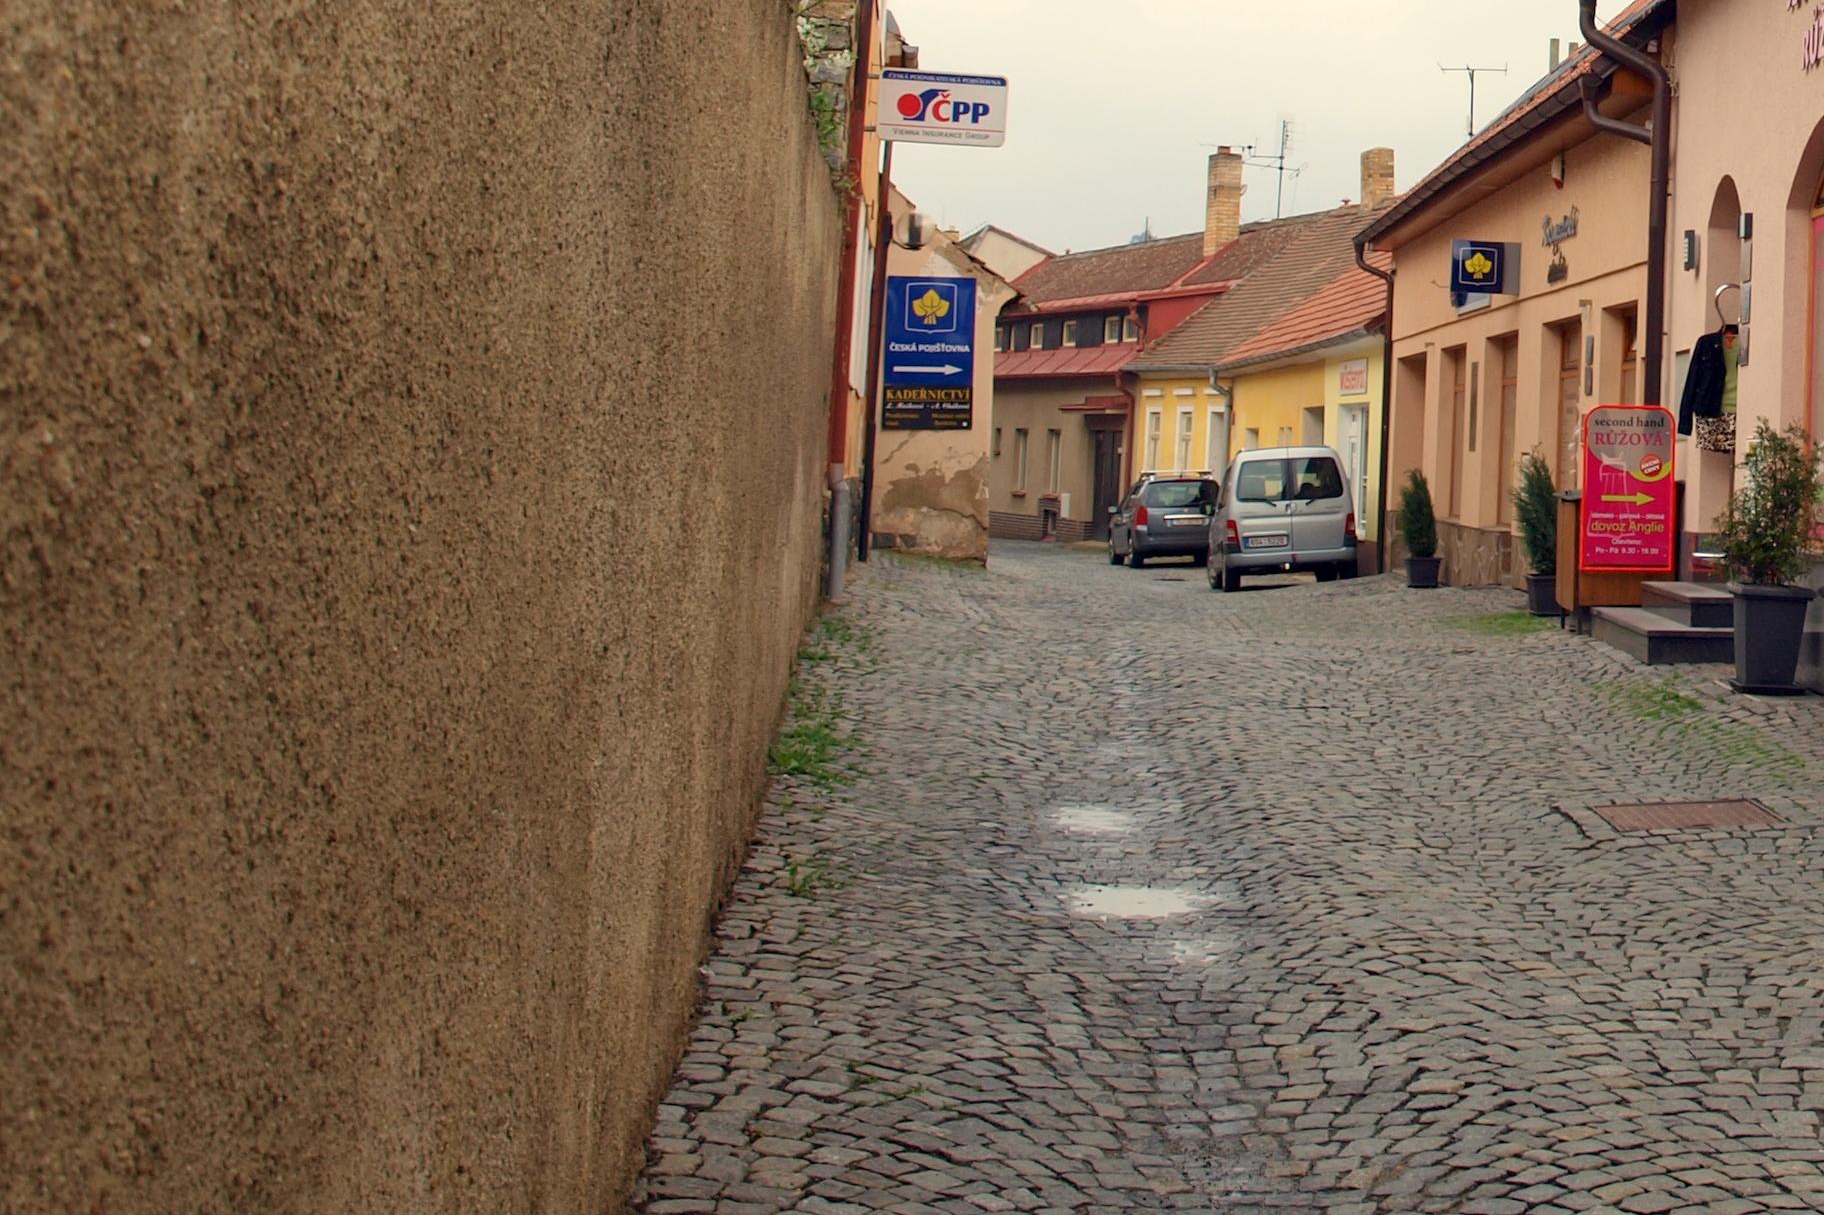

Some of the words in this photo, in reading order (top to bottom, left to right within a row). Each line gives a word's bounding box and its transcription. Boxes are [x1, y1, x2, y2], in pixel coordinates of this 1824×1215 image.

[932, 92, 990, 124] ČPP
[889, 341, 917, 352] ČESKÁ
[886, 388, 970, 400] KADEŘNICTVÍ
[1594, 417, 1634, 427] second
[1637, 417, 1664, 428] hand
[1595, 430, 1664, 445] RŮŽOVÁ
[1591, 521, 1626, 532] dovoz
[1628, 521, 1664, 535] Anglie
